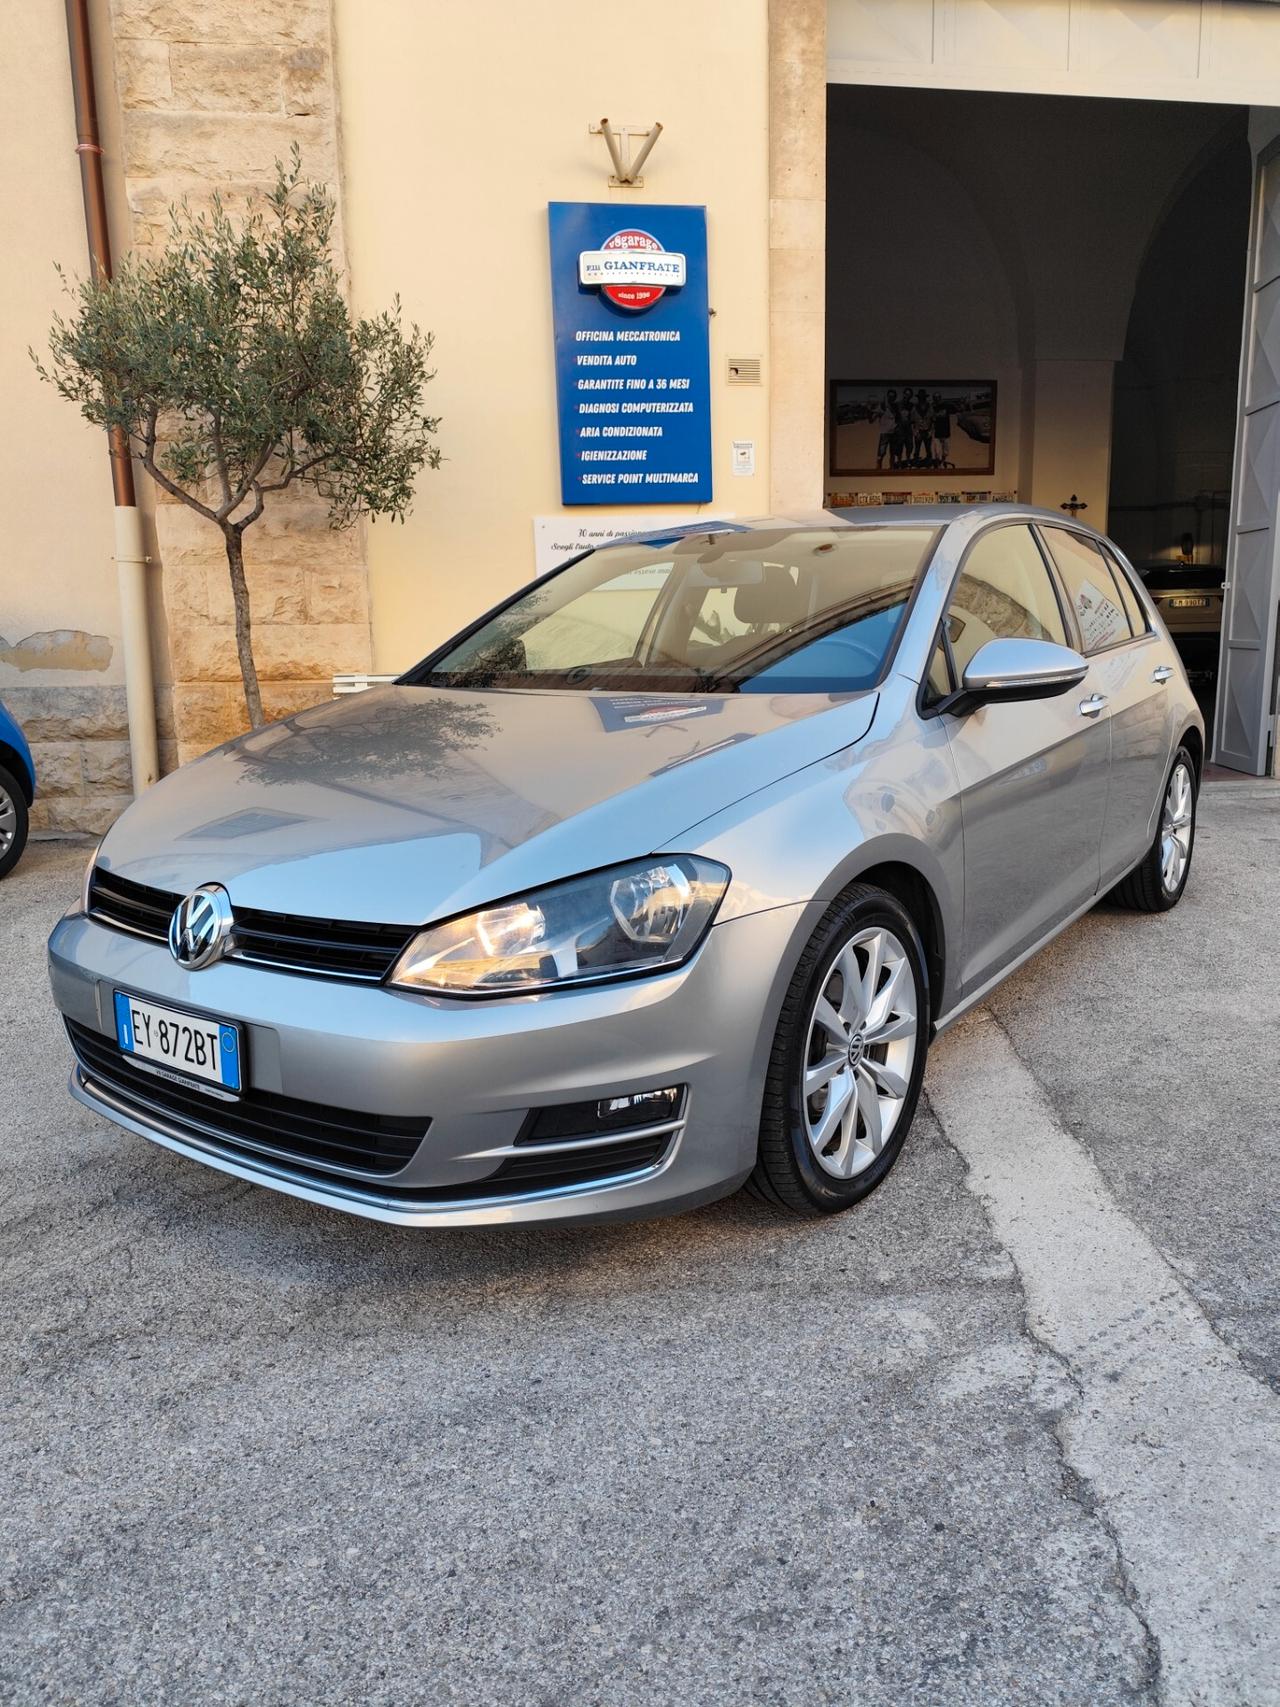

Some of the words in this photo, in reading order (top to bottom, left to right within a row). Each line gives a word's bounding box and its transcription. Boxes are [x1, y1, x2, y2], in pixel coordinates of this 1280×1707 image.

[604, 261, 680, 273] GIANFRATE
[575, 331, 614, 342] OFFICINA
[616, 331, 680, 342] MECCATRONICA
[576, 355, 613, 366] VENDITA
[614, 355, 637, 366] AUTO
[577, 379, 624, 390] GARANTITE
[626, 379, 646, 389] FINO
[648, 379, 654, 389] A
[655, 379, 668, 389] 36
[669, 378, 690, 389] MESI
[579, 402, 619, 414] DIAGNOSI
[621, 402, 694, 413] COMPUTERIZZATA
[579, 427, 600, 437] ARIA
[602, 426, 663, 437] CONDIZIONATA
[581, 450, 648, 461] IGIENIZZAZIONE
[582, 473, 616, 484] SERVICE
[618, 473, 643, 484] POINT
[645, 473, 699, 484] MULTIMARCA
[606, 529, 614, 537] di
[131, 1009, 152, 1048] EY
[158, 1020, 218, 1070] 872BT
